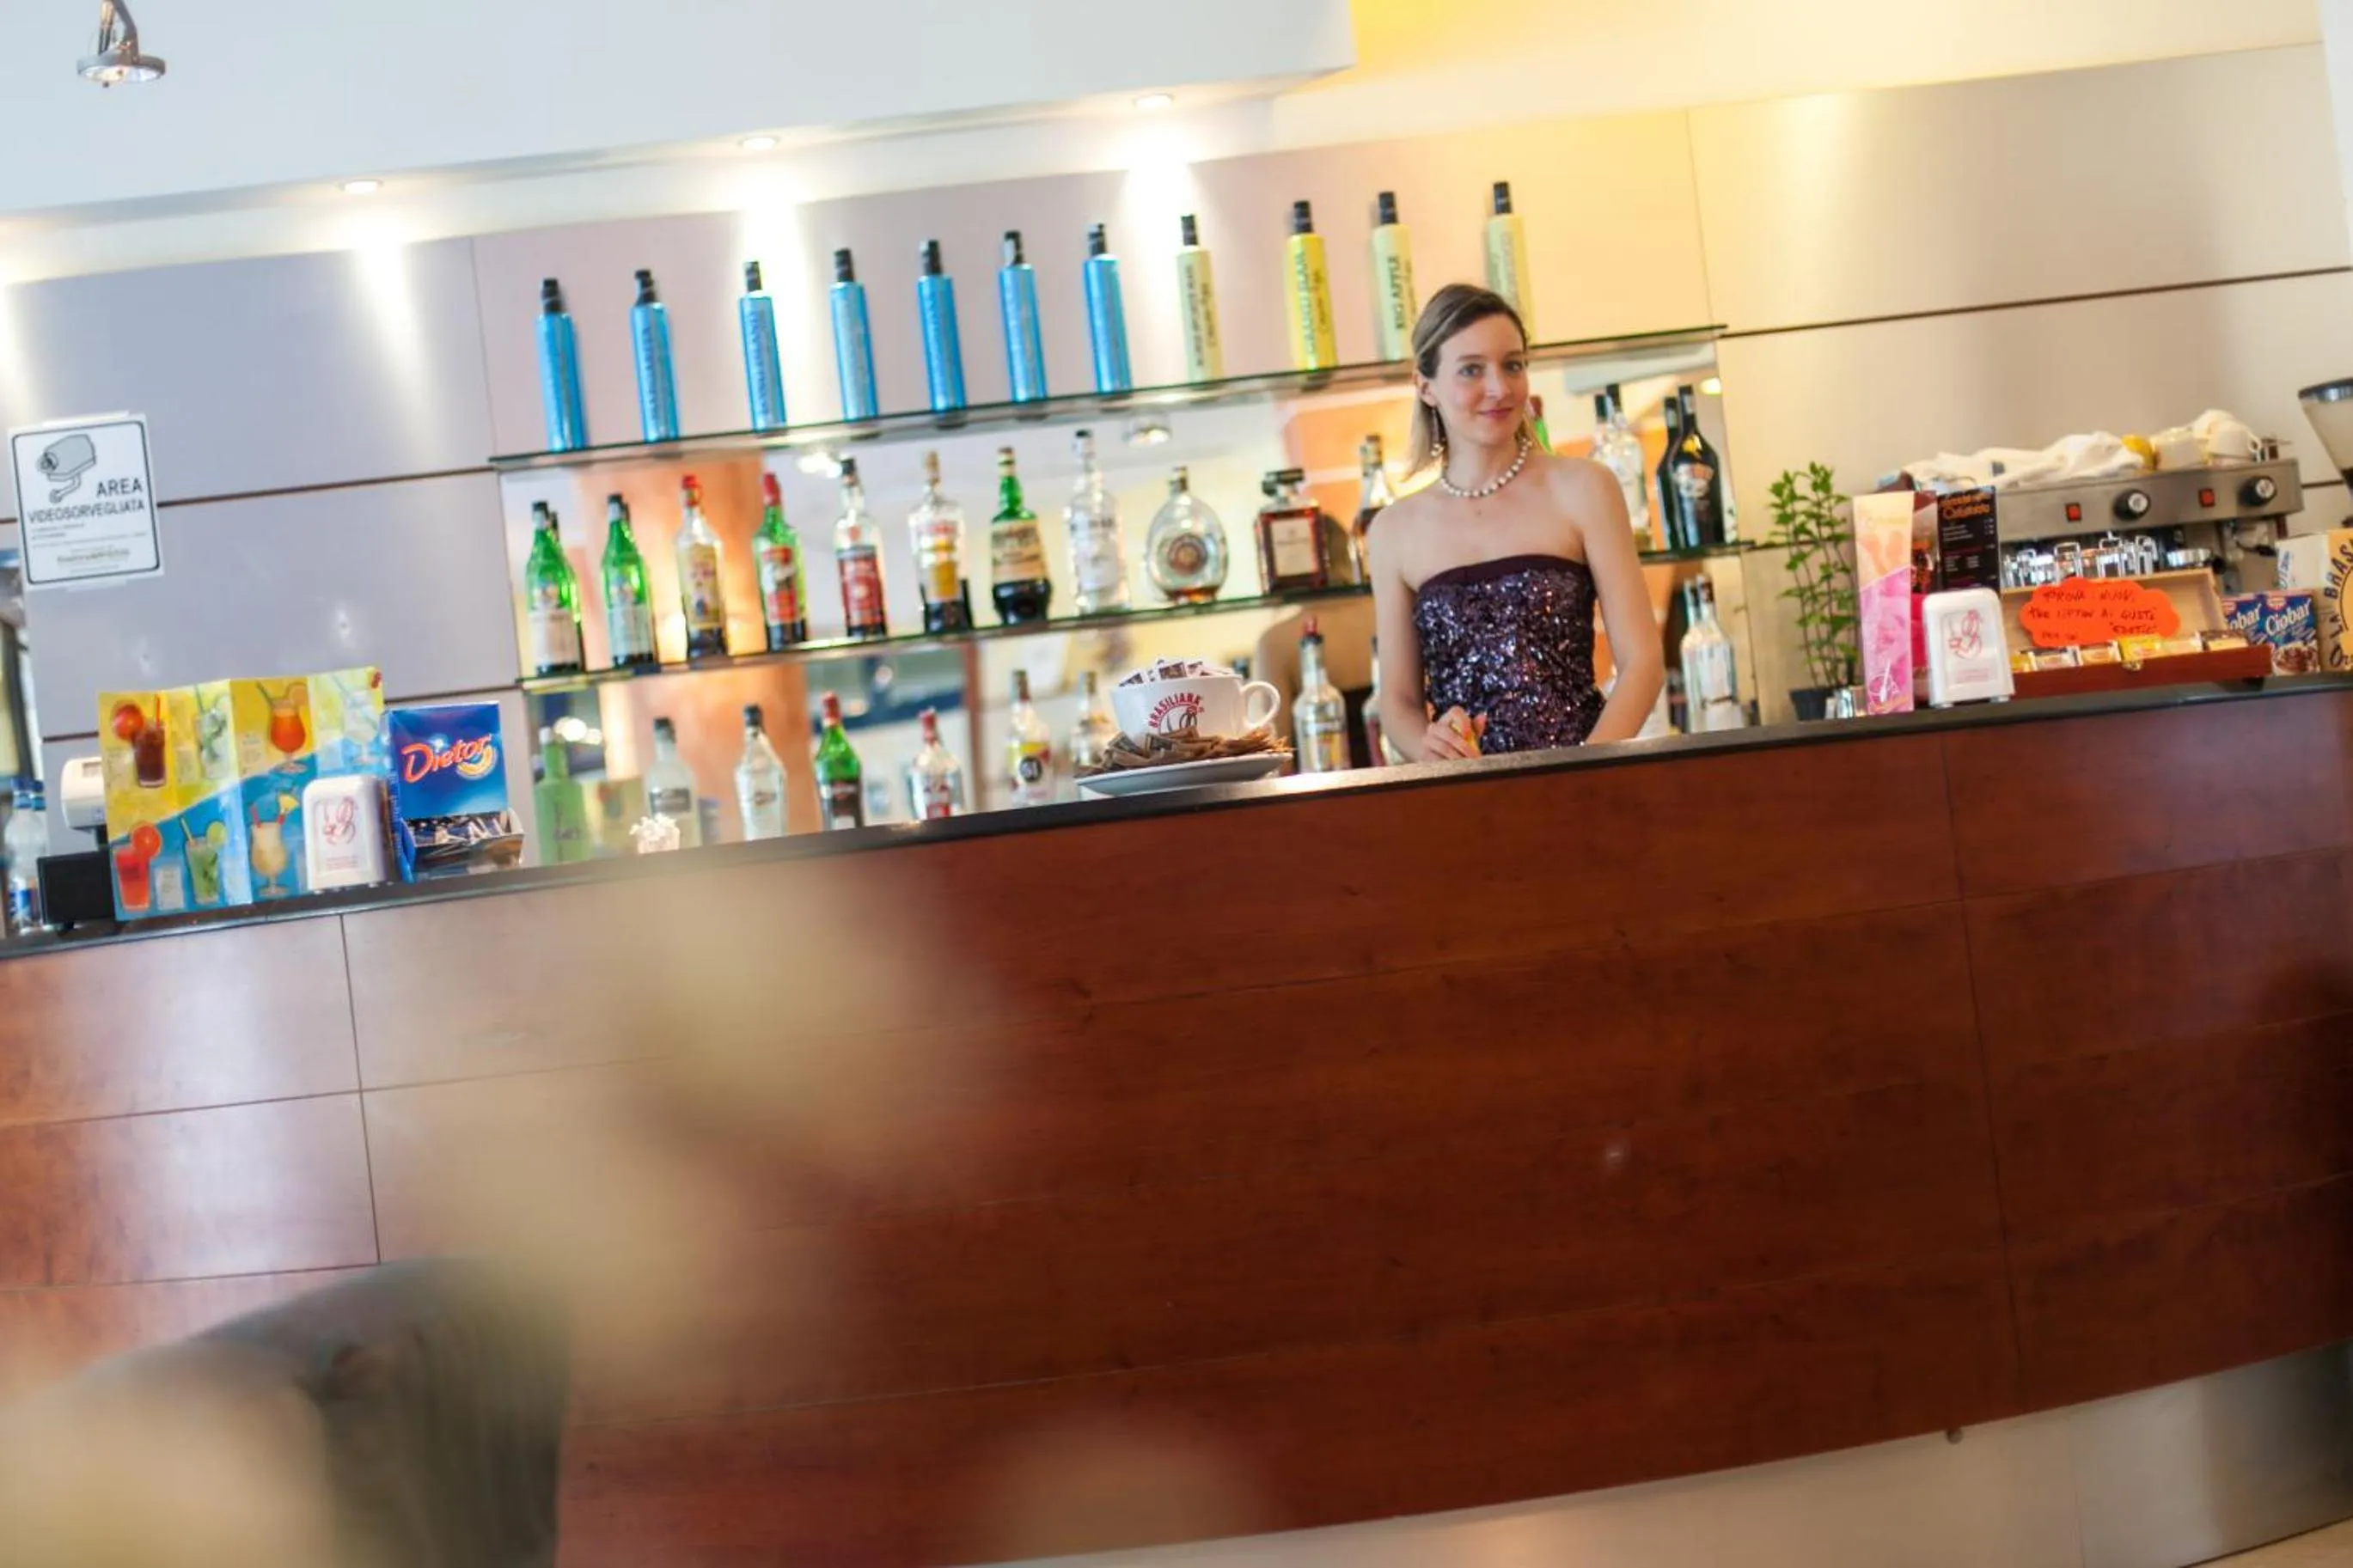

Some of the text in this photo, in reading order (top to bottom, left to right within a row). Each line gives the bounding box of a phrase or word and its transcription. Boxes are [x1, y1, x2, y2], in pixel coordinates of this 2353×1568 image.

[96, 478, 144, 497] AREA
[27, 499, 145, 524] VIDEOSORVEGLIATA
[2323, 538, 2353, 600] BRAS
[2265, 597, 2312, 636] Ciobar
[400, 733, 492, 784] Dietor
